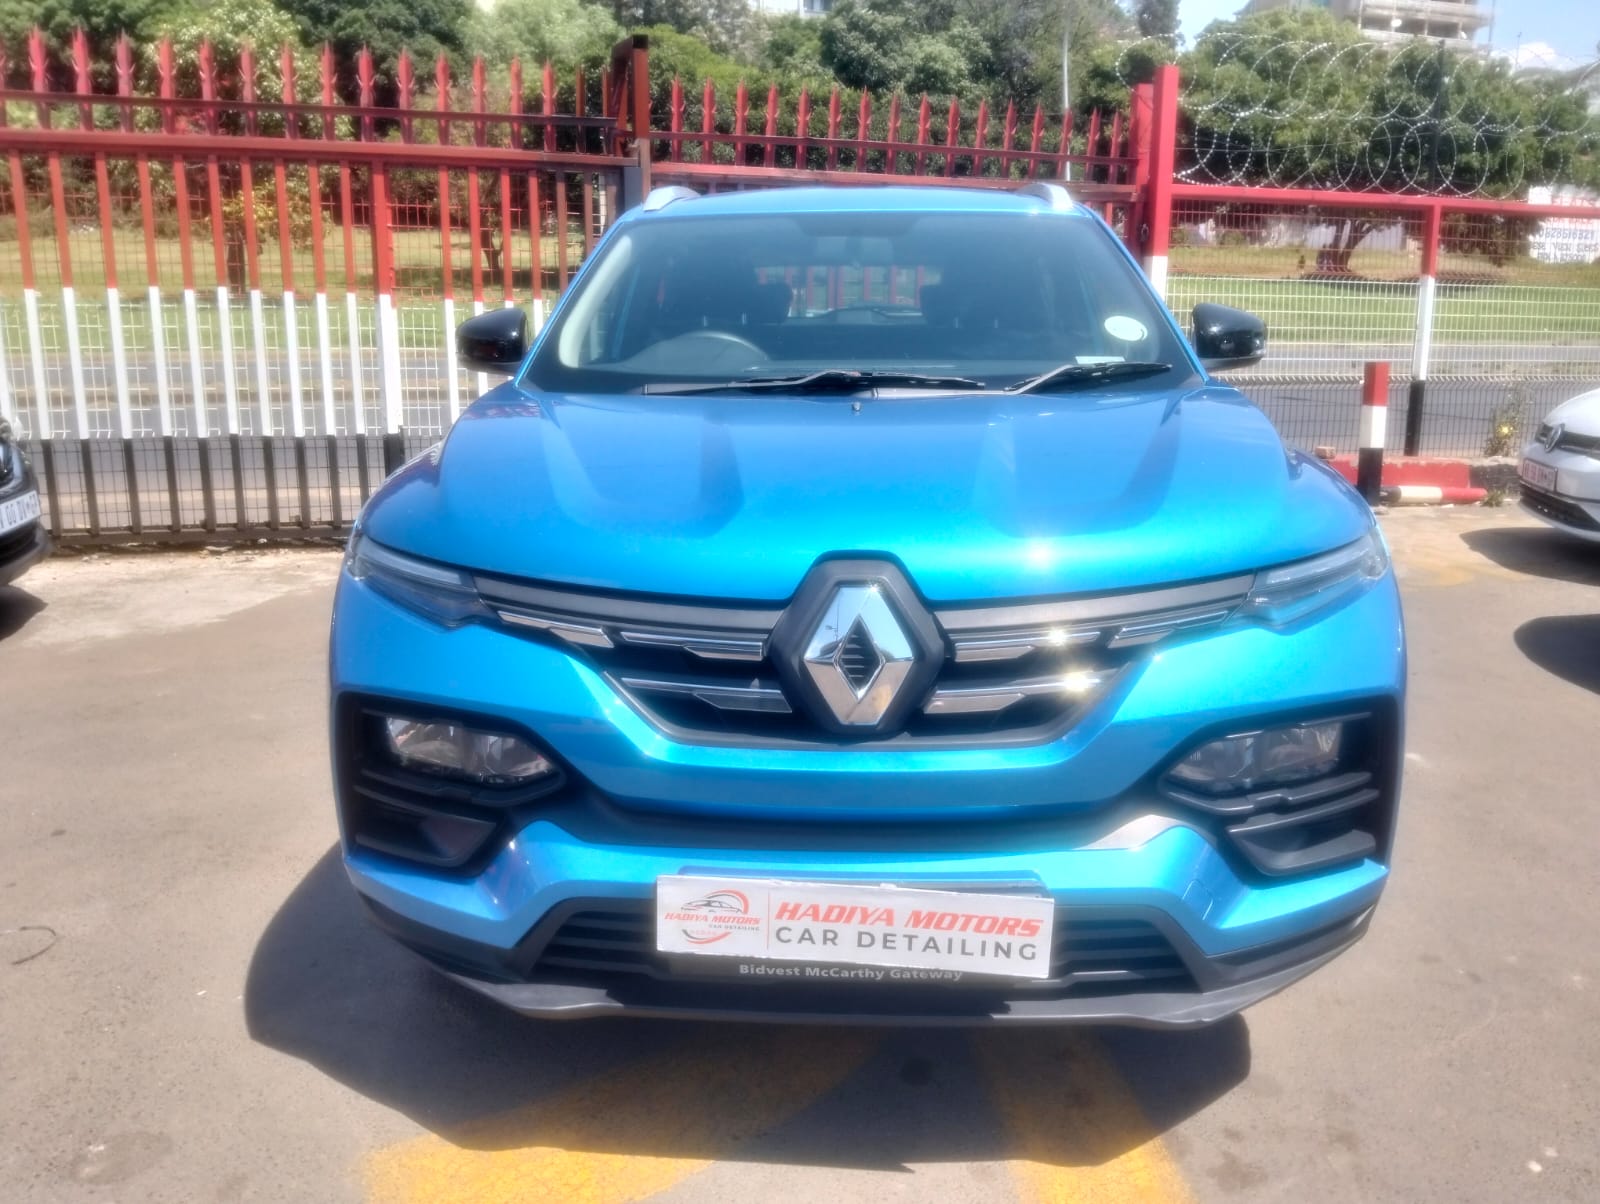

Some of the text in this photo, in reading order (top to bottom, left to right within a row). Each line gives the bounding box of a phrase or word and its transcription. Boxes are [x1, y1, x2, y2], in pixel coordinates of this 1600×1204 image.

[664, 912, 761, 925] HADIYA MOTORS
[775, 901, 1044, 938] HADIYA MOTORS
[775, 926, 1037, 961] CAR DETAILING
[739, 964, 963, 982] Bidvest McCarthy Gateway
